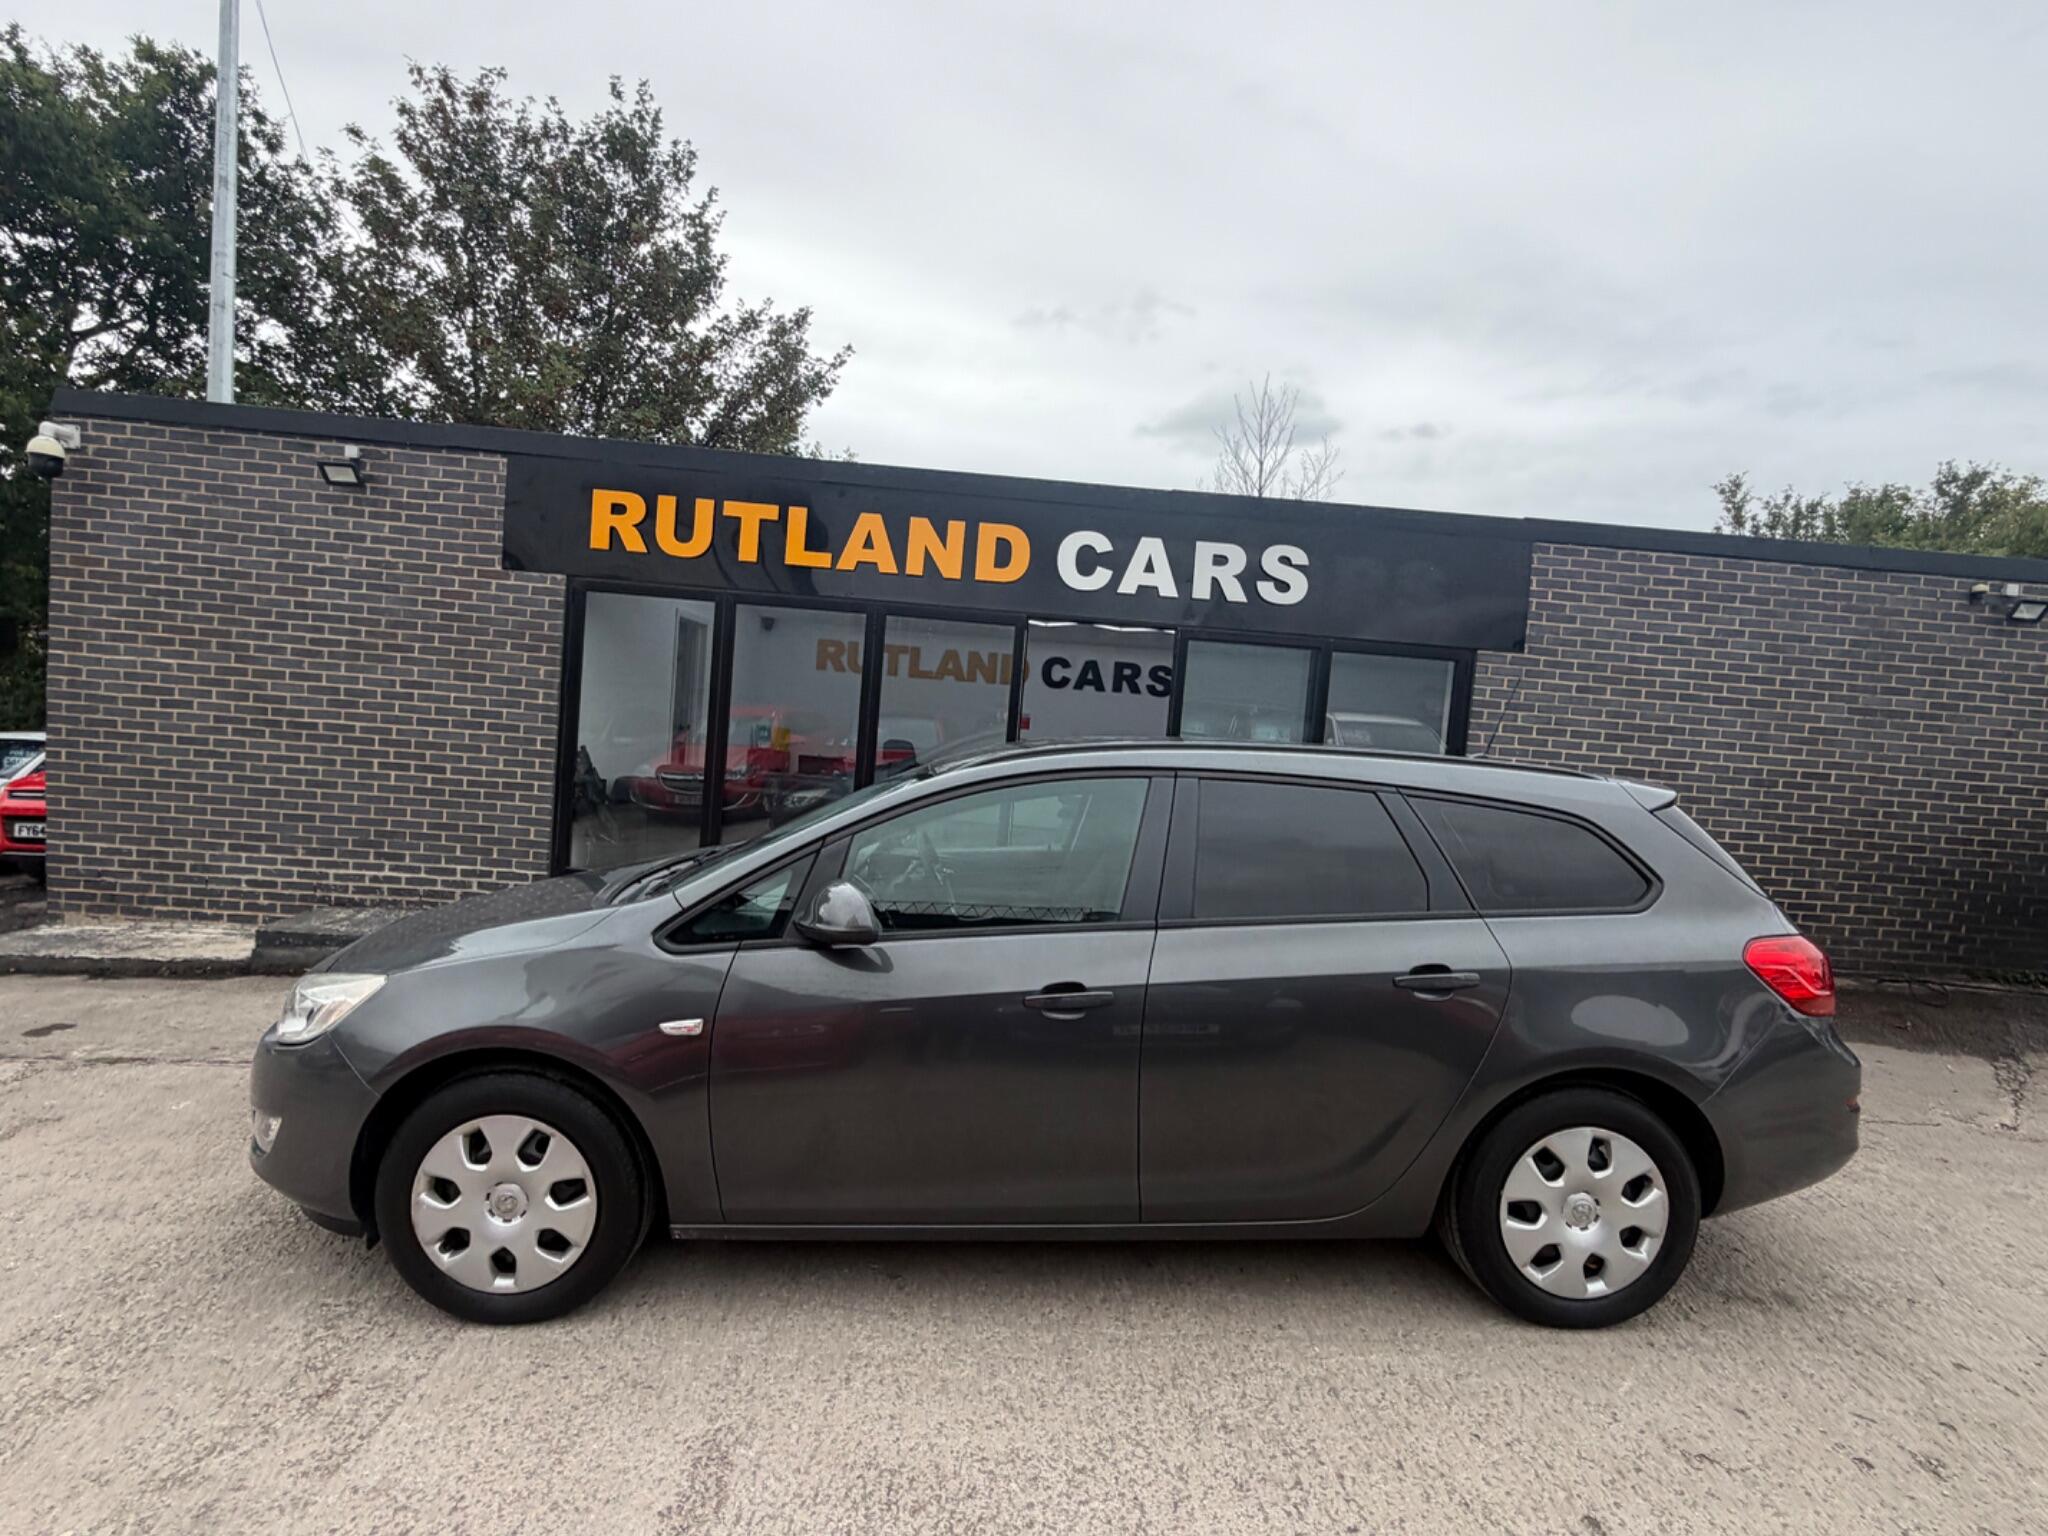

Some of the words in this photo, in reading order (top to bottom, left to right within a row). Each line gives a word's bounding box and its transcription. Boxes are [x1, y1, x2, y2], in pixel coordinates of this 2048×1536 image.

[589, 488, 1031, 583] RUTLAND
[1056, 530, 1310, 605] CARS
[1041, 656, 1173, 697] CARS
